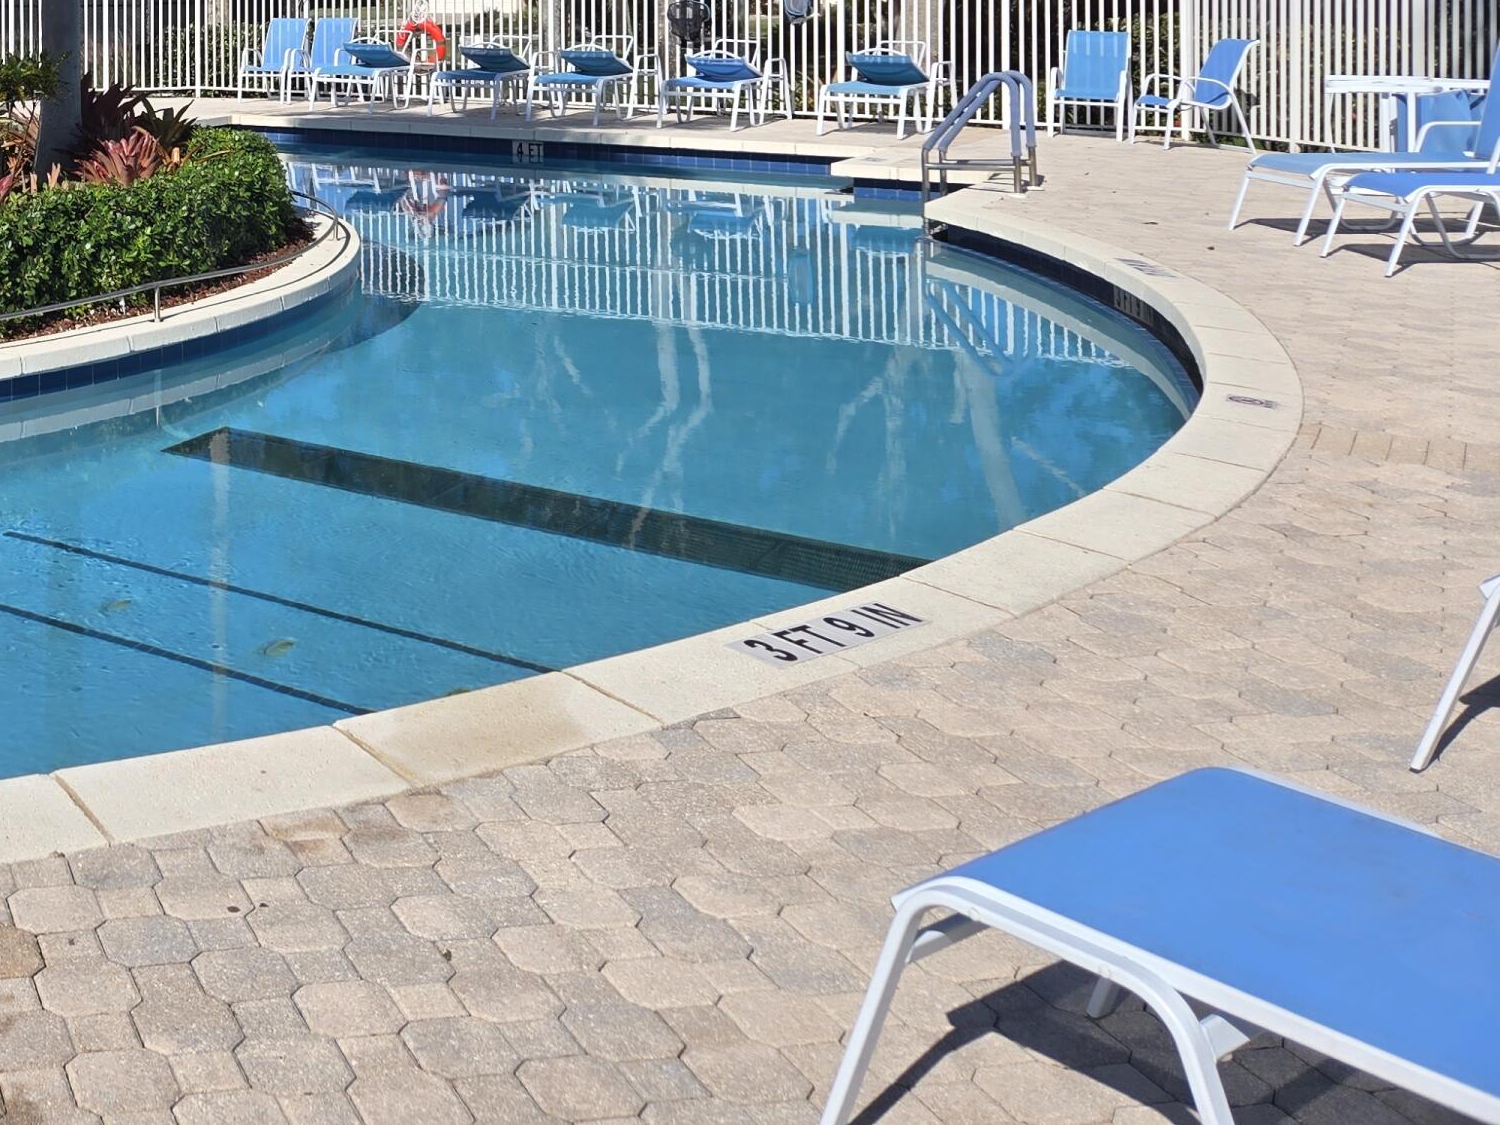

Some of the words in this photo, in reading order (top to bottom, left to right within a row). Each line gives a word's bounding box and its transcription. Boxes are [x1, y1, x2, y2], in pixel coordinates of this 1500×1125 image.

[743, 639, 798, 662] 3
[771, 625, 847, 654] FT
[823, 617, 875, 638] 9
[850, 603, 925, 629] IN
